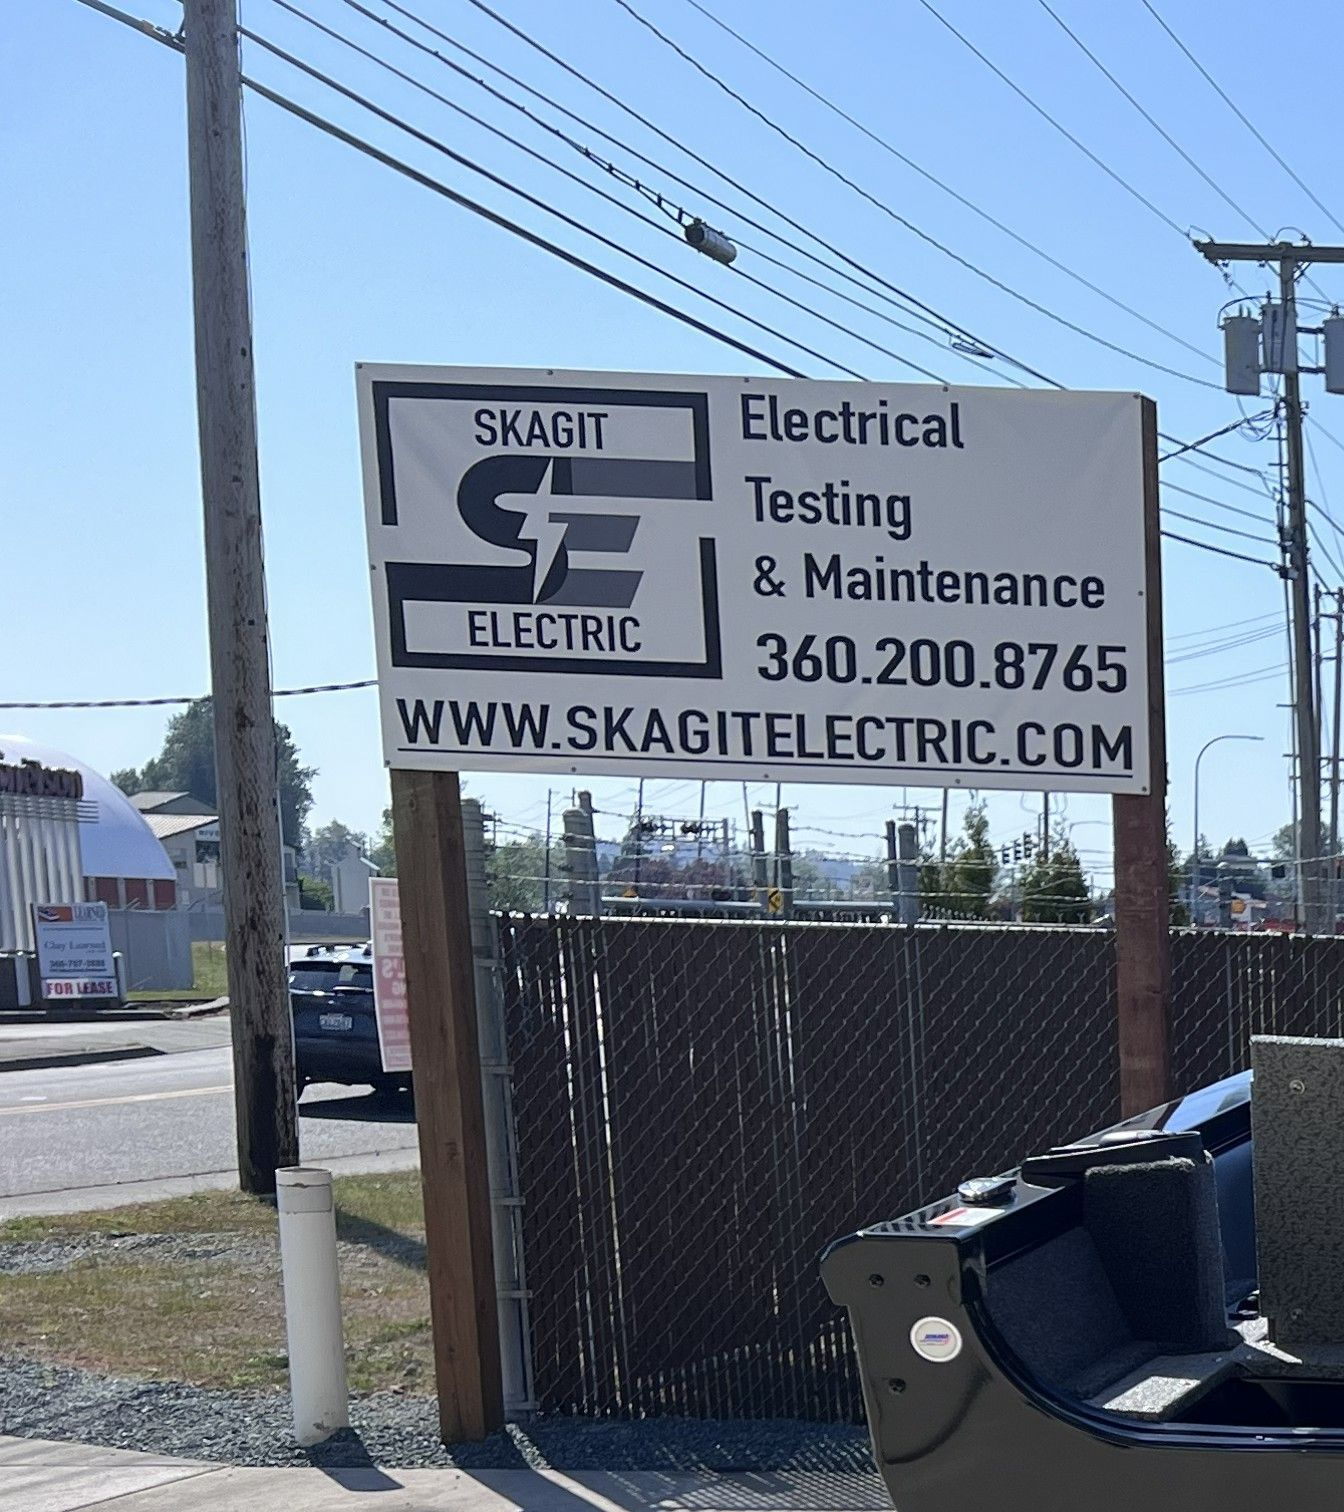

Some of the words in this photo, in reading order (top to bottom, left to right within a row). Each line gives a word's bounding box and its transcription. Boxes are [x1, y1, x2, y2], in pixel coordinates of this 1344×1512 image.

[473, 408, 609, 450] SKAGIT
[740, 393, 965, 450] Electrical
[744, 475, 912, 541] Testing
[753, 555, 786, 597] &
[804, 552, 1105, 609] Maintenance
[467, 610, 642, 653] ELECTRIC
[756, 632, 1128, 694] 360.200.8765
[396, 697, 1133, 770] WWW.SKAGITELECTRIC.COM
[46, 982, 73, 995] FOR
[76, 980, 114, 994] LEASE
